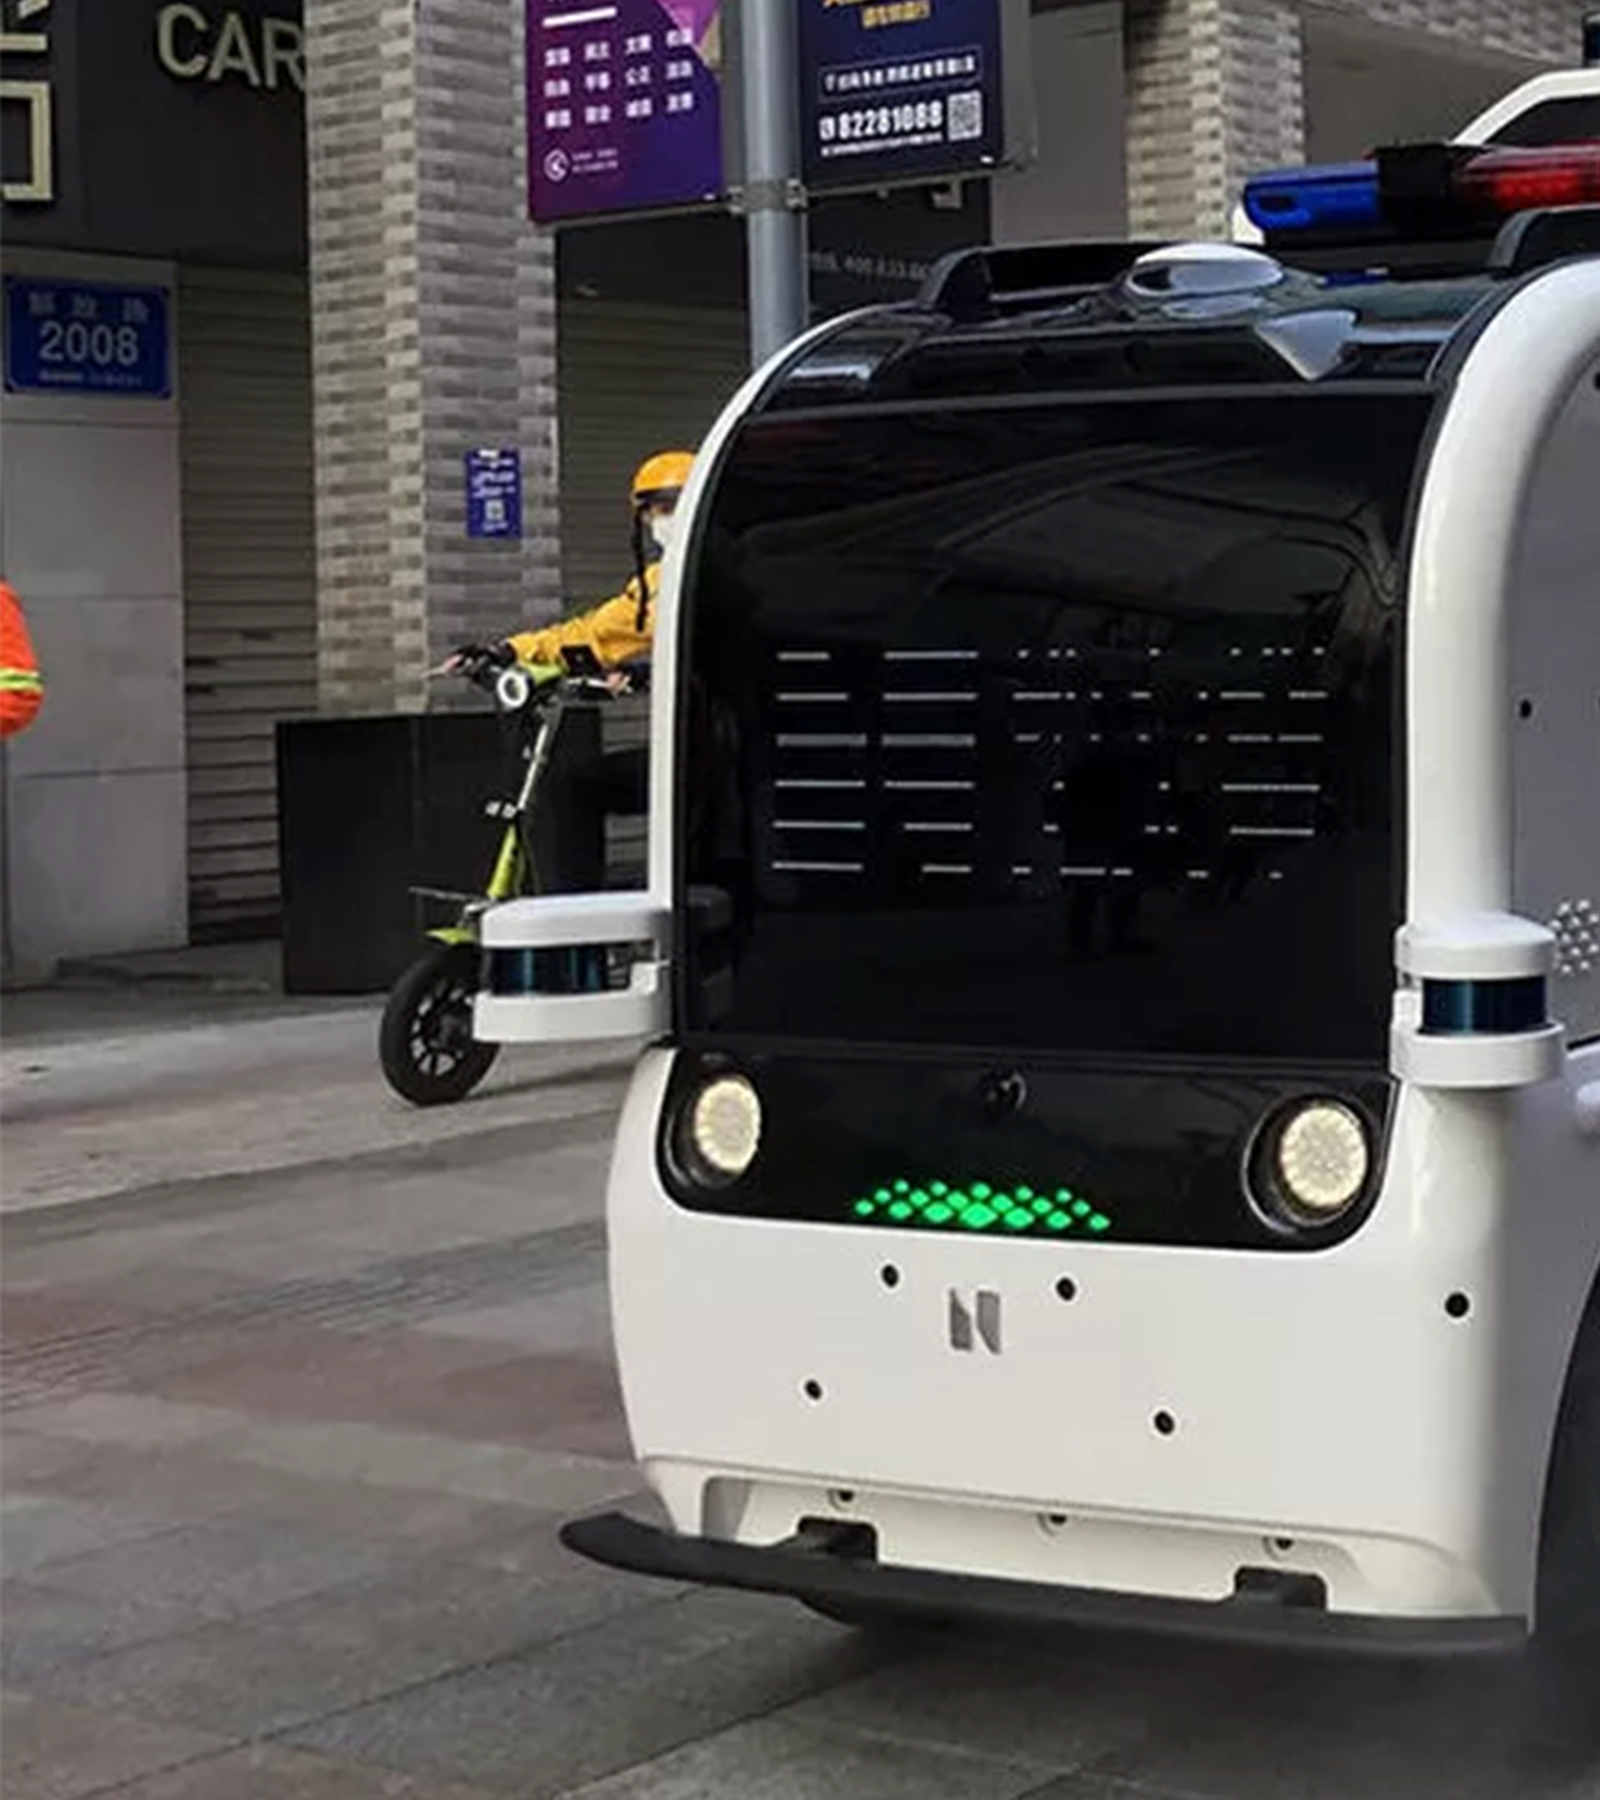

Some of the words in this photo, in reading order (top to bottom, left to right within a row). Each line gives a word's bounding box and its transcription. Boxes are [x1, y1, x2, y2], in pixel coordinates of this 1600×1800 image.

[157, 3, 306, 89] CAR
[838, 101, 943, 139] 82281088
[39, 320, 139, 366] 2008
